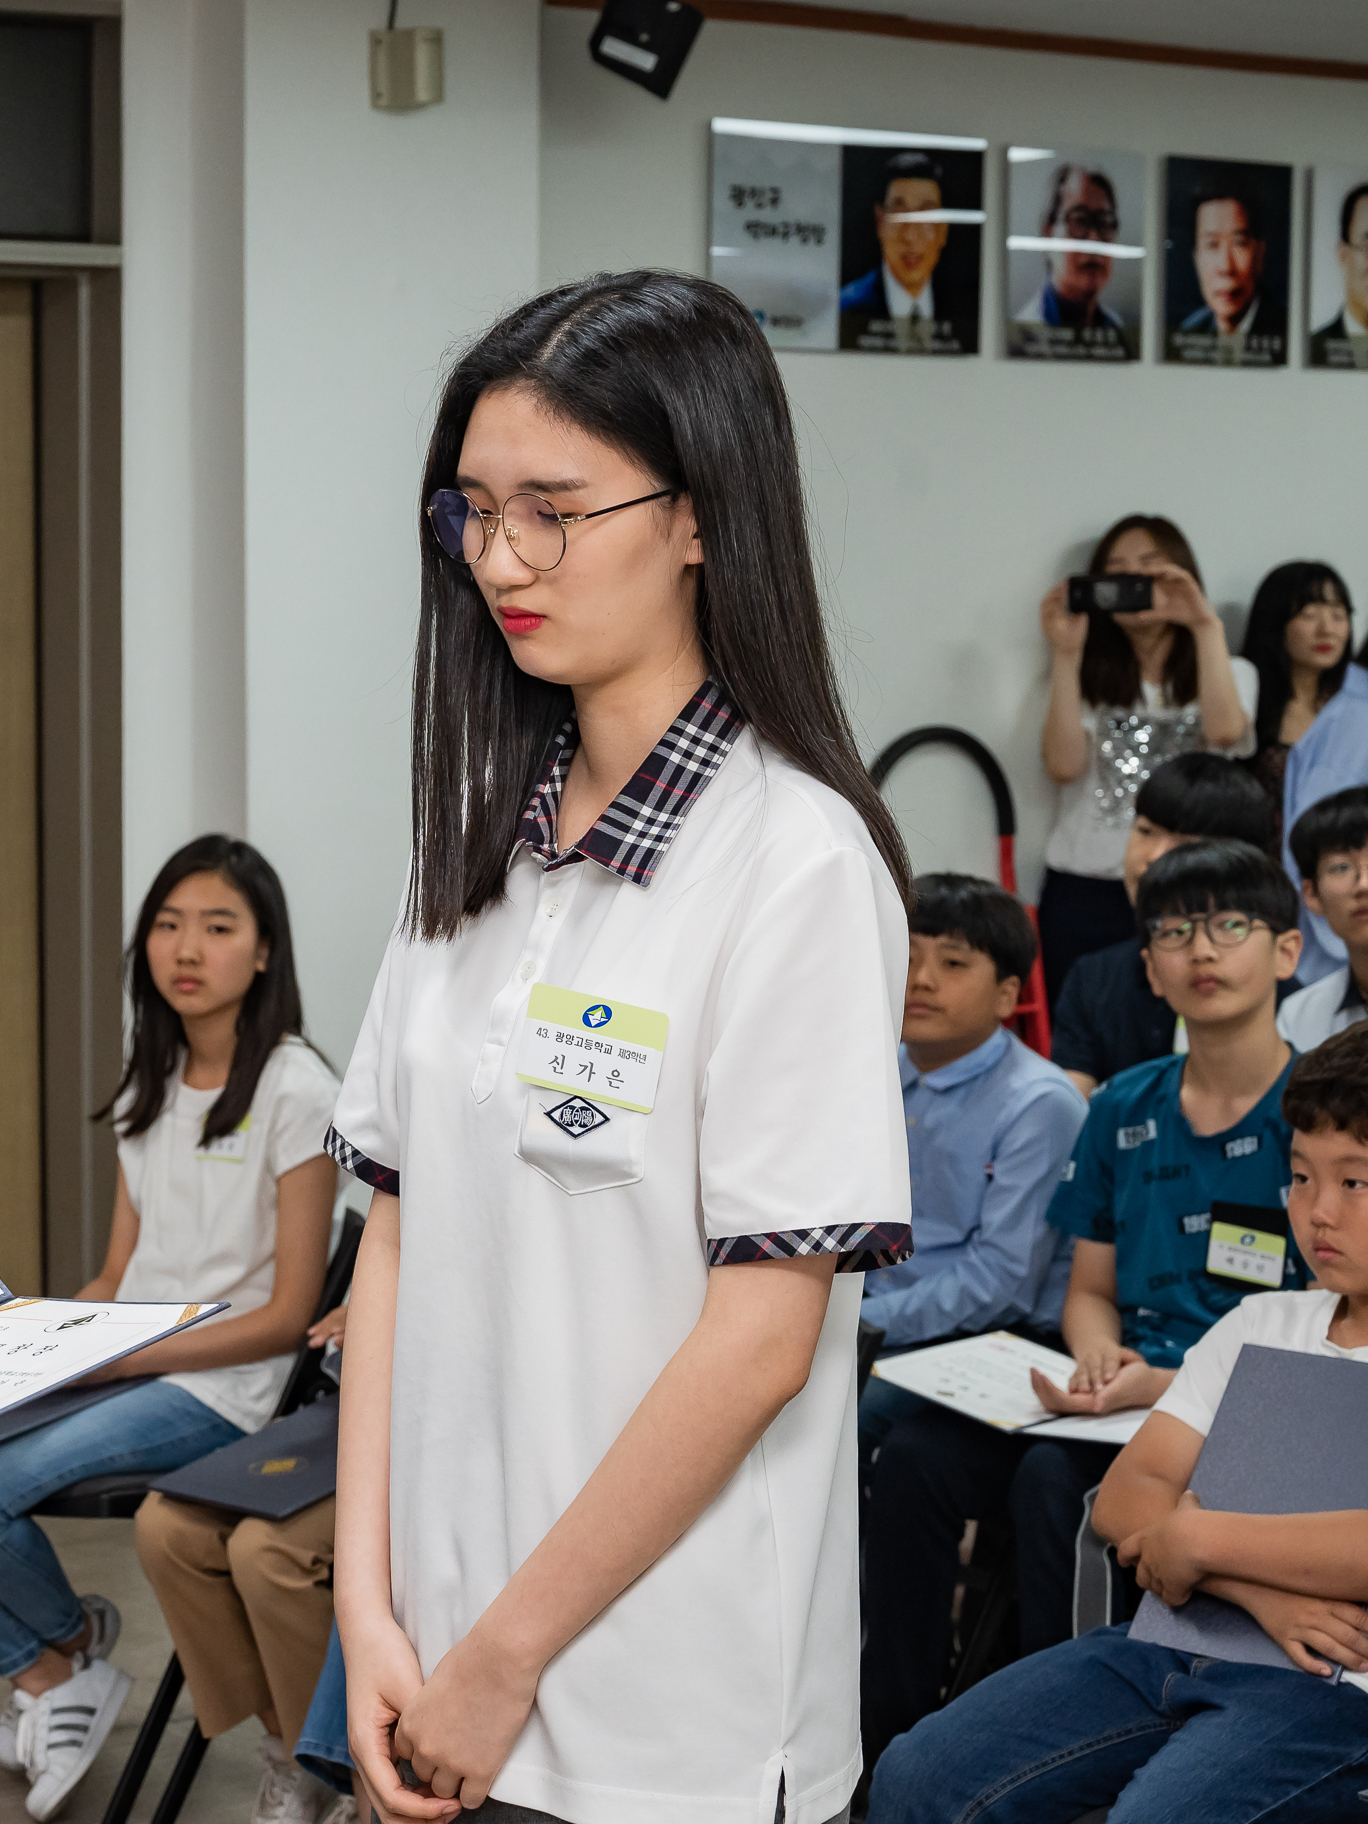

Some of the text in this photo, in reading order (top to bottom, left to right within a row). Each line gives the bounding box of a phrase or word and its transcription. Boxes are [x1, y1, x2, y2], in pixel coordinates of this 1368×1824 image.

[536, 1027, 647, 1064] 43. 광양고등학교 제3학년
